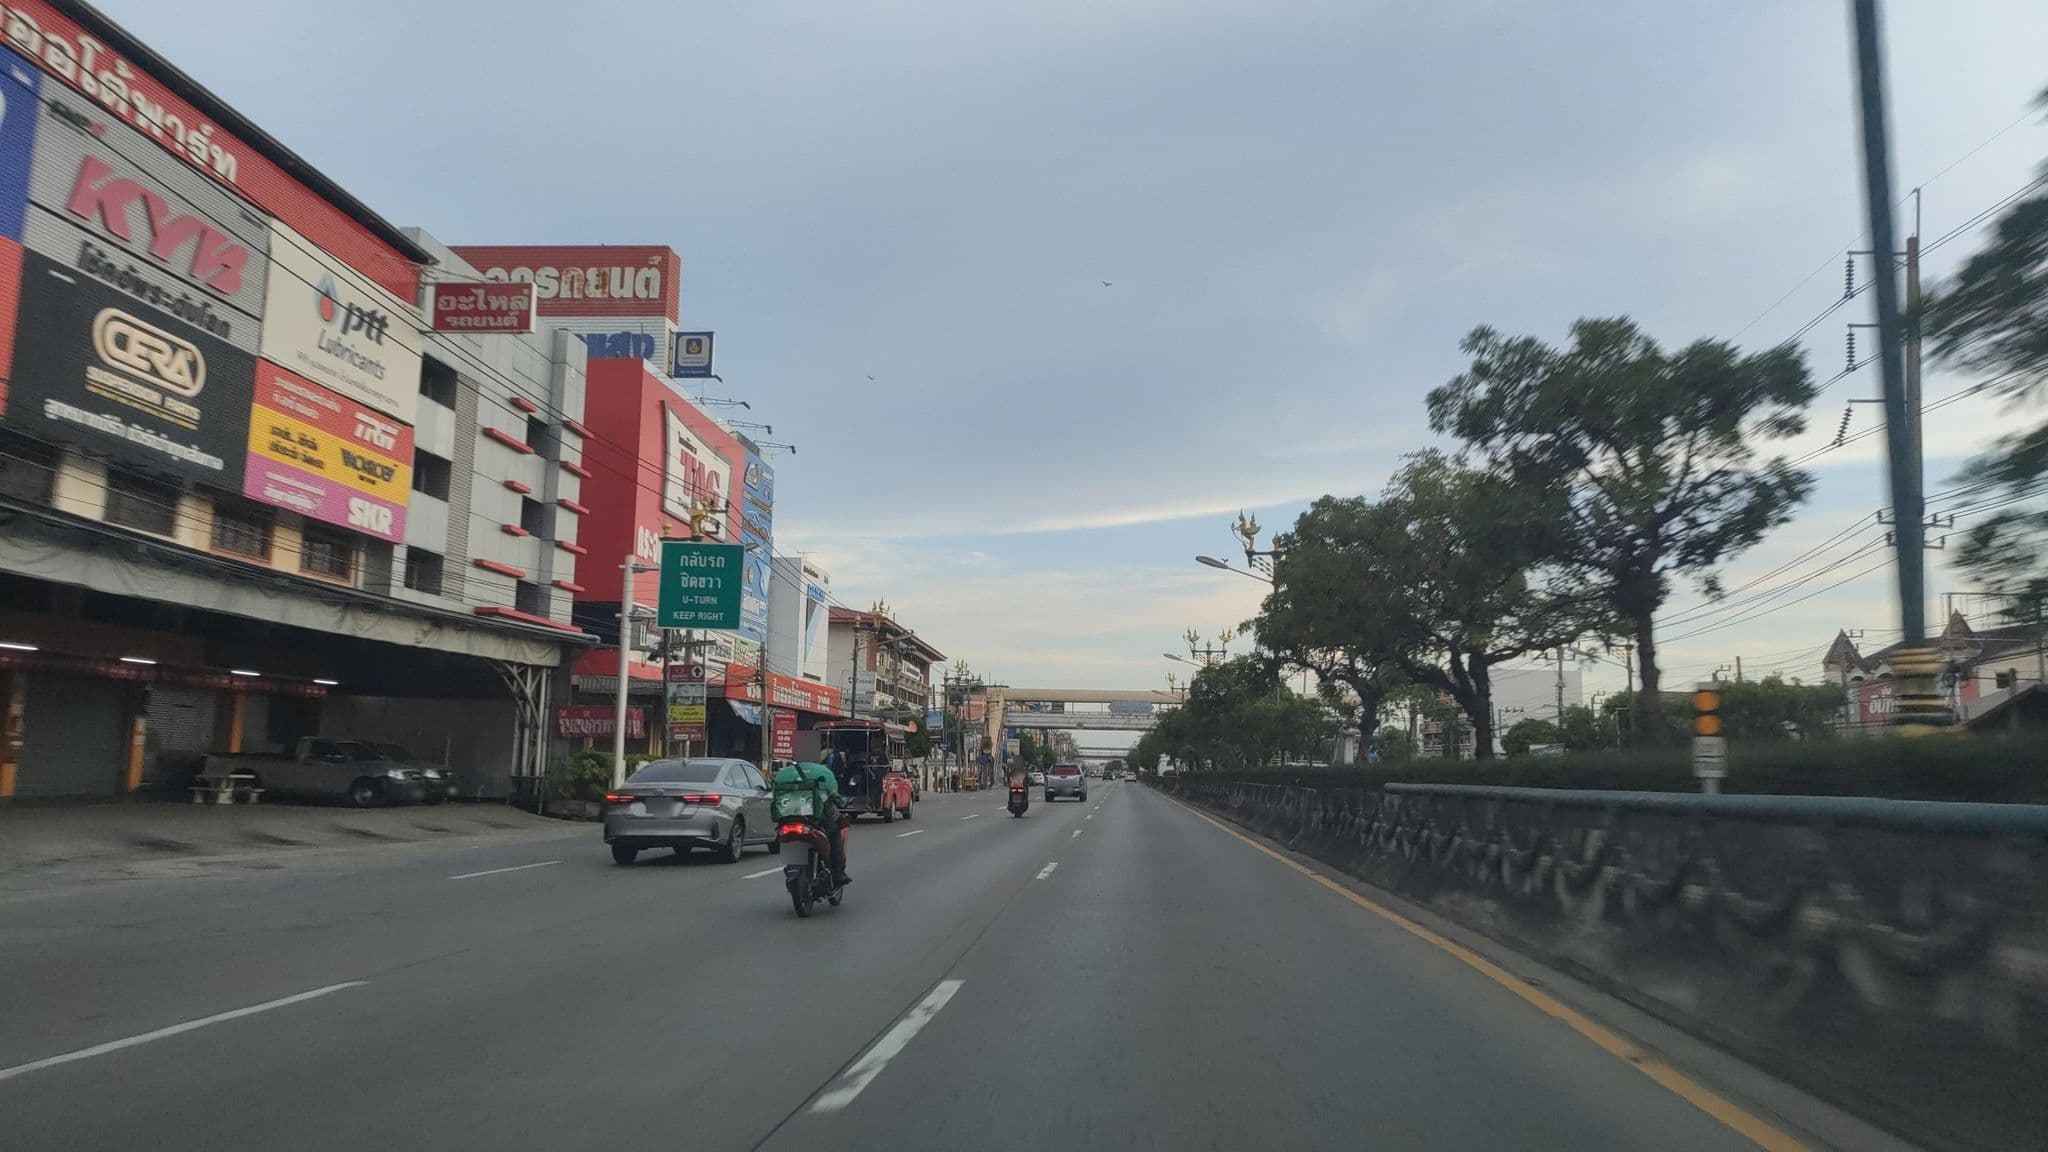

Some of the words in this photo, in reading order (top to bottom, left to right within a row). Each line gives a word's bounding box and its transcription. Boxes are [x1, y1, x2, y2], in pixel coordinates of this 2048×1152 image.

[66, 152, 249, 296] KYB
[437, 288, 530, 312] อะไหล่
[341, 301, 390, 346] ptt
[445, 311, 520, 328] รถยนต์
[103, 319, 196, 392] CERA
[318, 328, 386, 381] Lubricants
[354, 411, 402, 451] TRW
[347, 496, 394, 536] SKR
[680, 551, 725, 568] กลับรถ
[680, 572, 722, 589] ชิดขวา
[673, 611, 696, 621] KEEP
[698, 611, 724, 621] RIGHT
[682, 595, 718, 605] U-TURN
